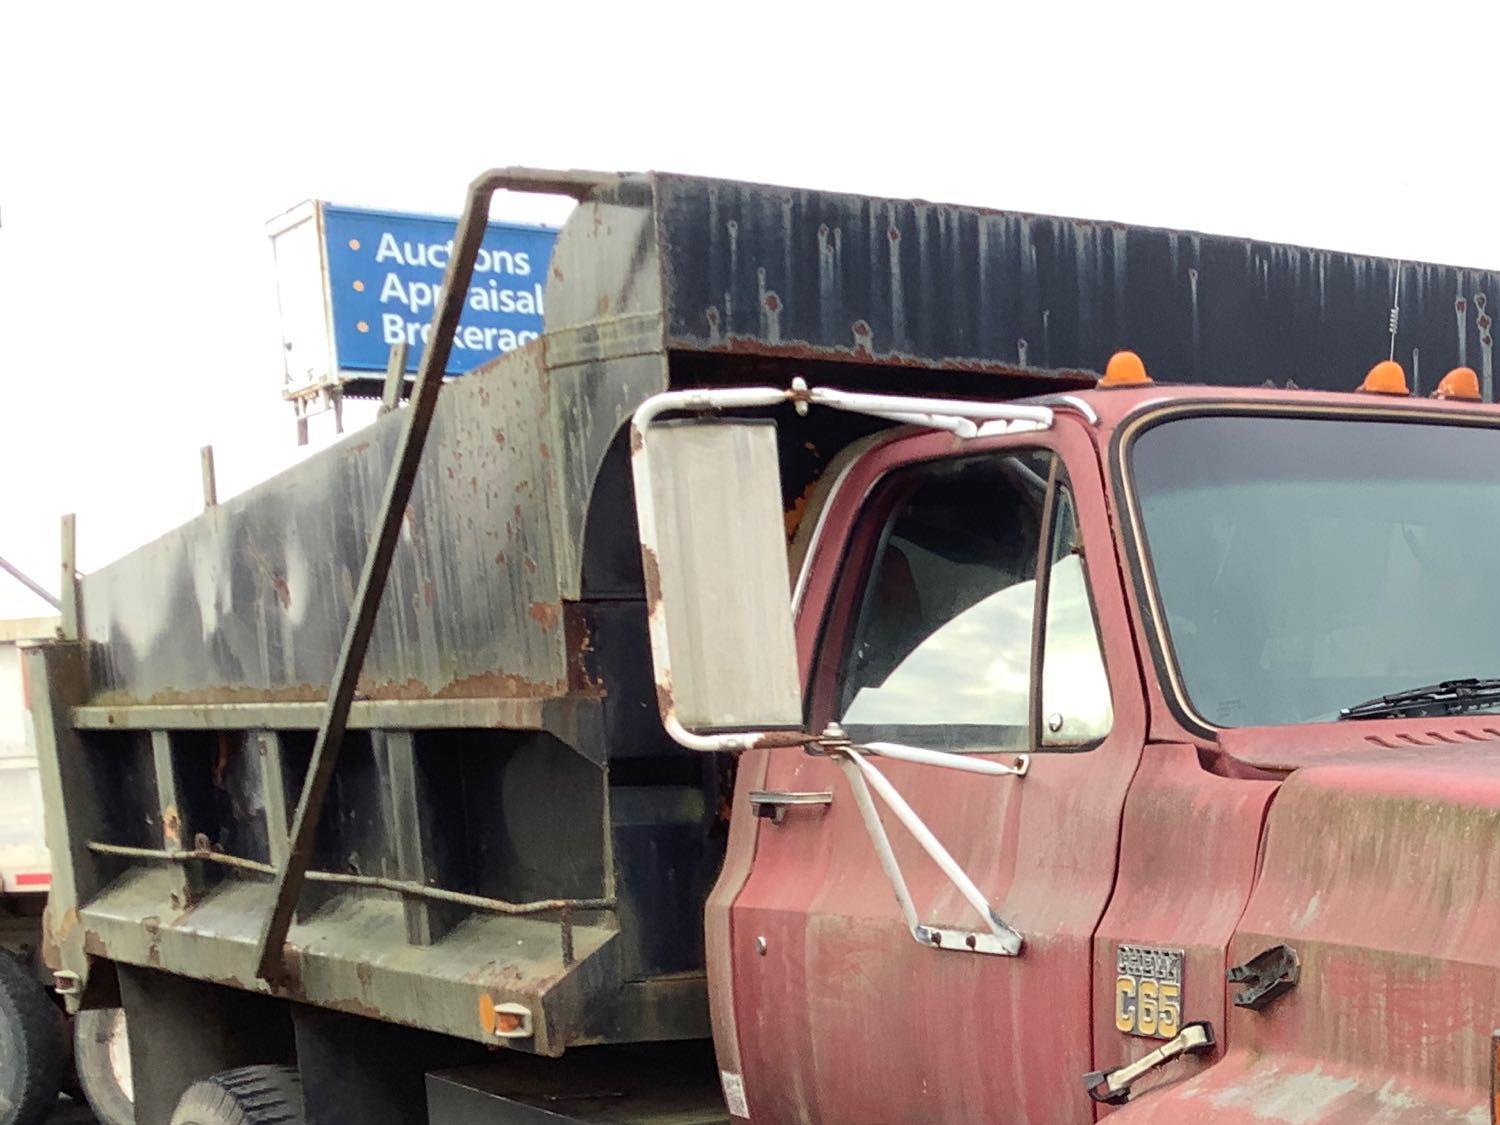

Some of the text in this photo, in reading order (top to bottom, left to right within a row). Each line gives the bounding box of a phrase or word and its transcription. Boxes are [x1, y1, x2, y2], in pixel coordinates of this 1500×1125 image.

[376, 232, 531, 276] Auctons
[379, 272, 545, 316] Apaisal
[1116, 945, 1183, 983] CHEVY
[1115, 974, 1181, 1038] C65
